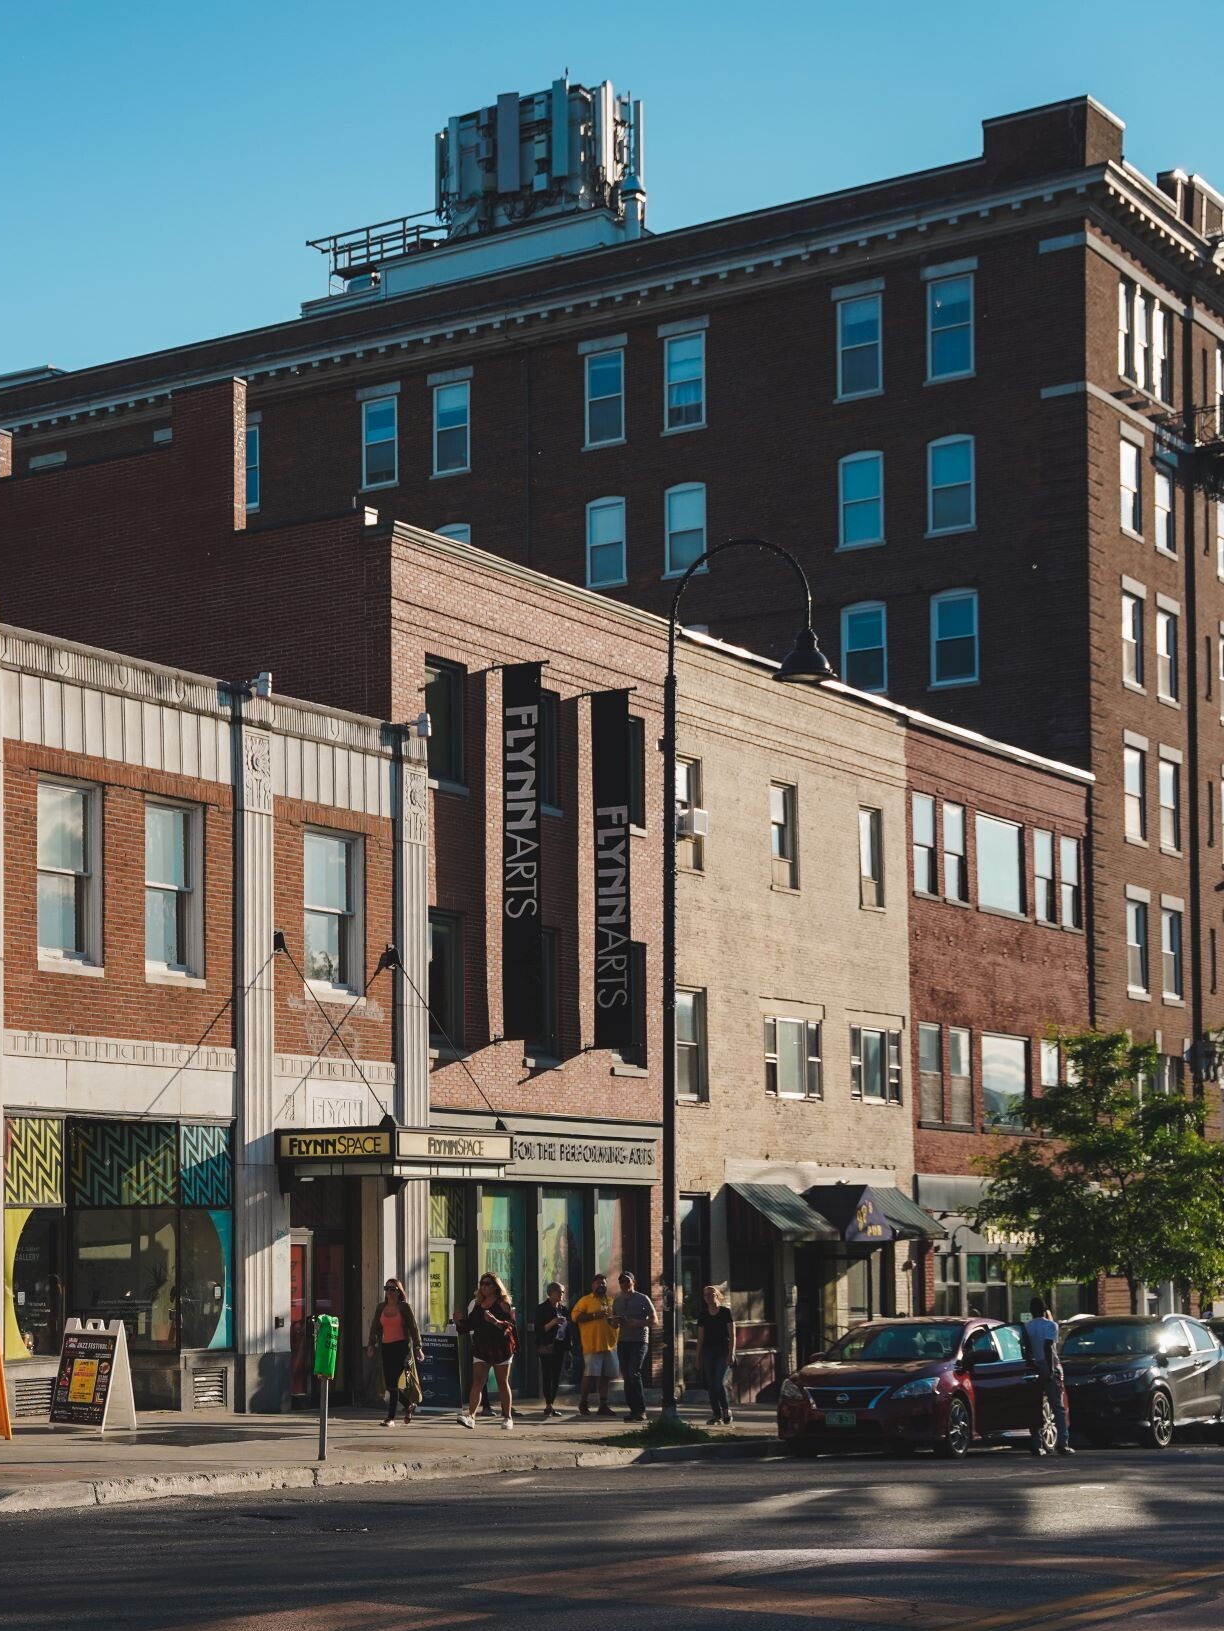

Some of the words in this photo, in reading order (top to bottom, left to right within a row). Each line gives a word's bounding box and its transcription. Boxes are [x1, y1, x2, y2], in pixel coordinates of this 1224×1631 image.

[505, 705, 541, 919] FLYNNARTS
[596, 804, 631, 1009] FLYNNARTS
[537, 1142, 556, 1161] THE
[629, 1147, 655, 1166] ARTS
